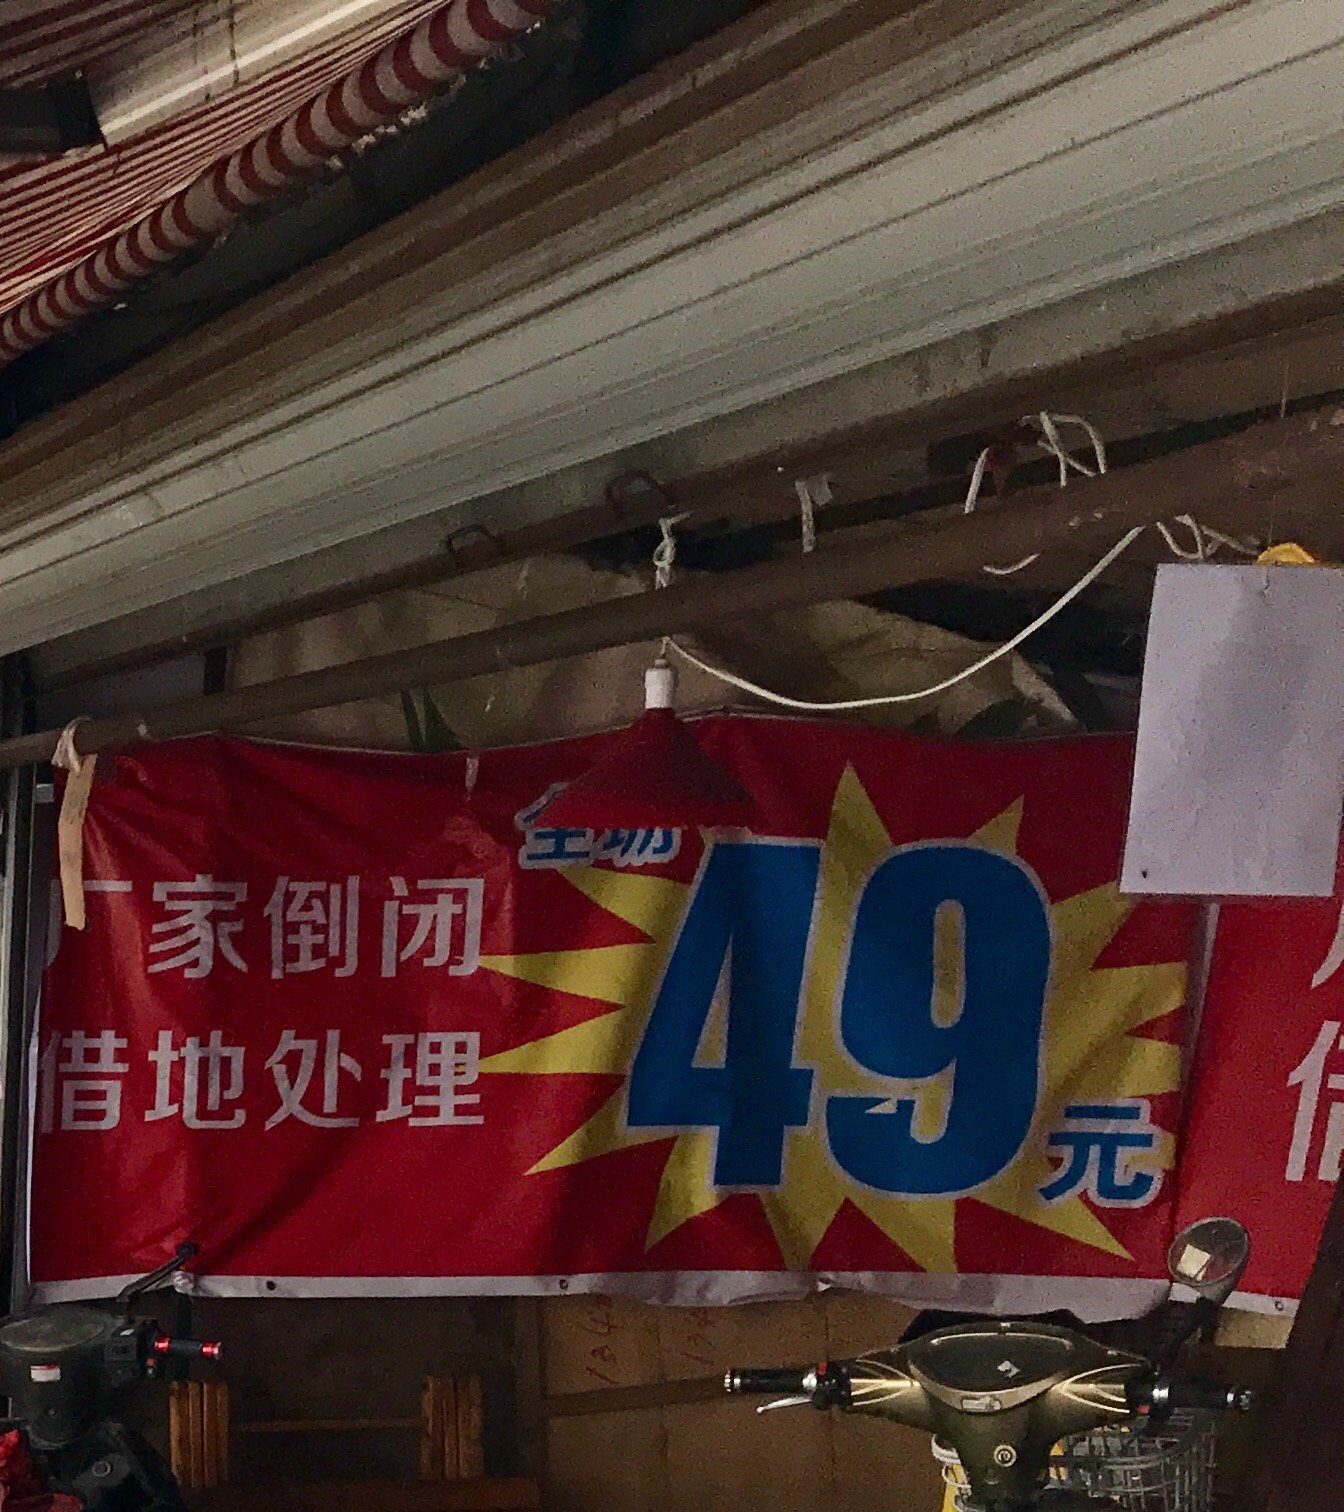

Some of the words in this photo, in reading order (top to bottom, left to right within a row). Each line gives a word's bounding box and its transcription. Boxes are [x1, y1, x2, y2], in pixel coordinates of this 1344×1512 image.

[625, 838, 1052, 1197] 49
[38, 1028, 486, 1133] 借地处理
[1036, 1100, 1164, 1208] 元
